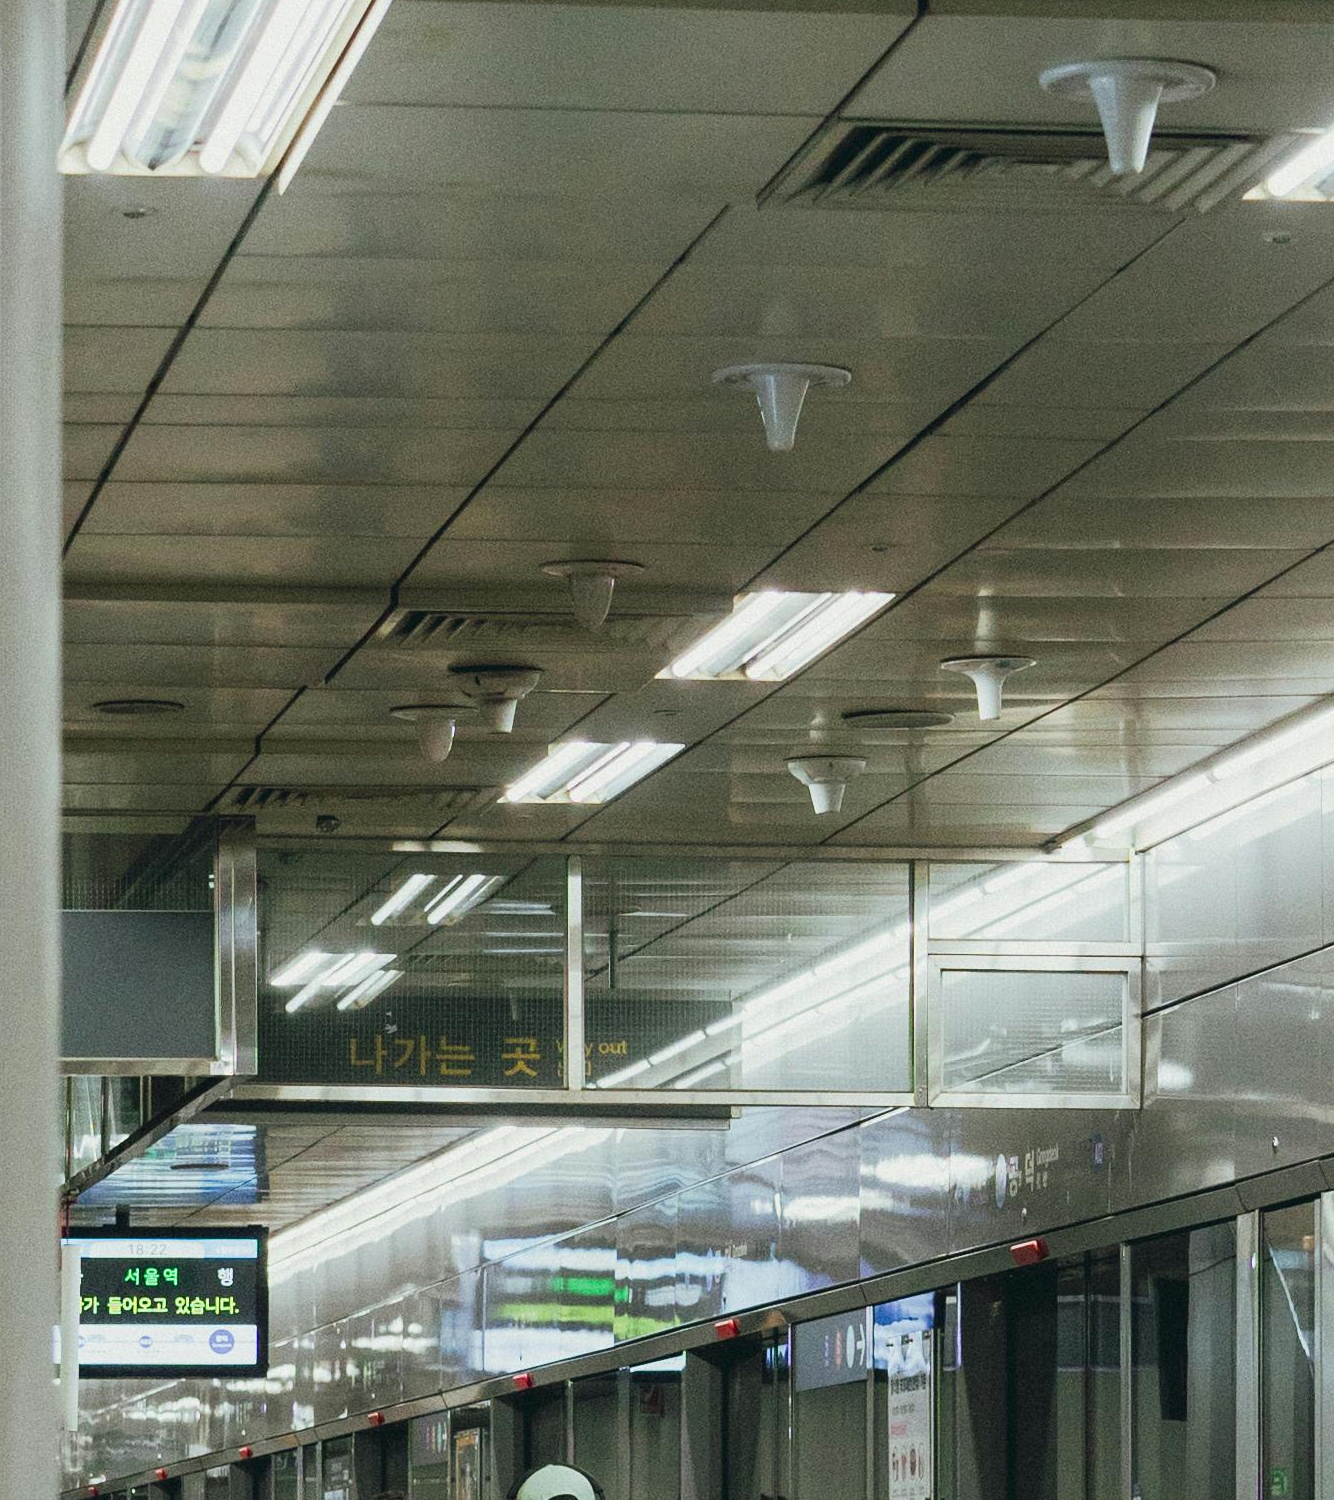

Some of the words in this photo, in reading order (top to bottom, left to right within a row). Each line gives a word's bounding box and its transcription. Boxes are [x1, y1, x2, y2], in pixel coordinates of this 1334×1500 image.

[349, 1034, 475, 1077] 나가는
[502, 1036, 541, 1078] 곳
[599, 1039, 628, 1056] out
[124, 1267, 179, 1286] 서울역
[107, 1296, 168, 1315] 들어오고
[174, 1296, 240, 1315] 있습니다.
